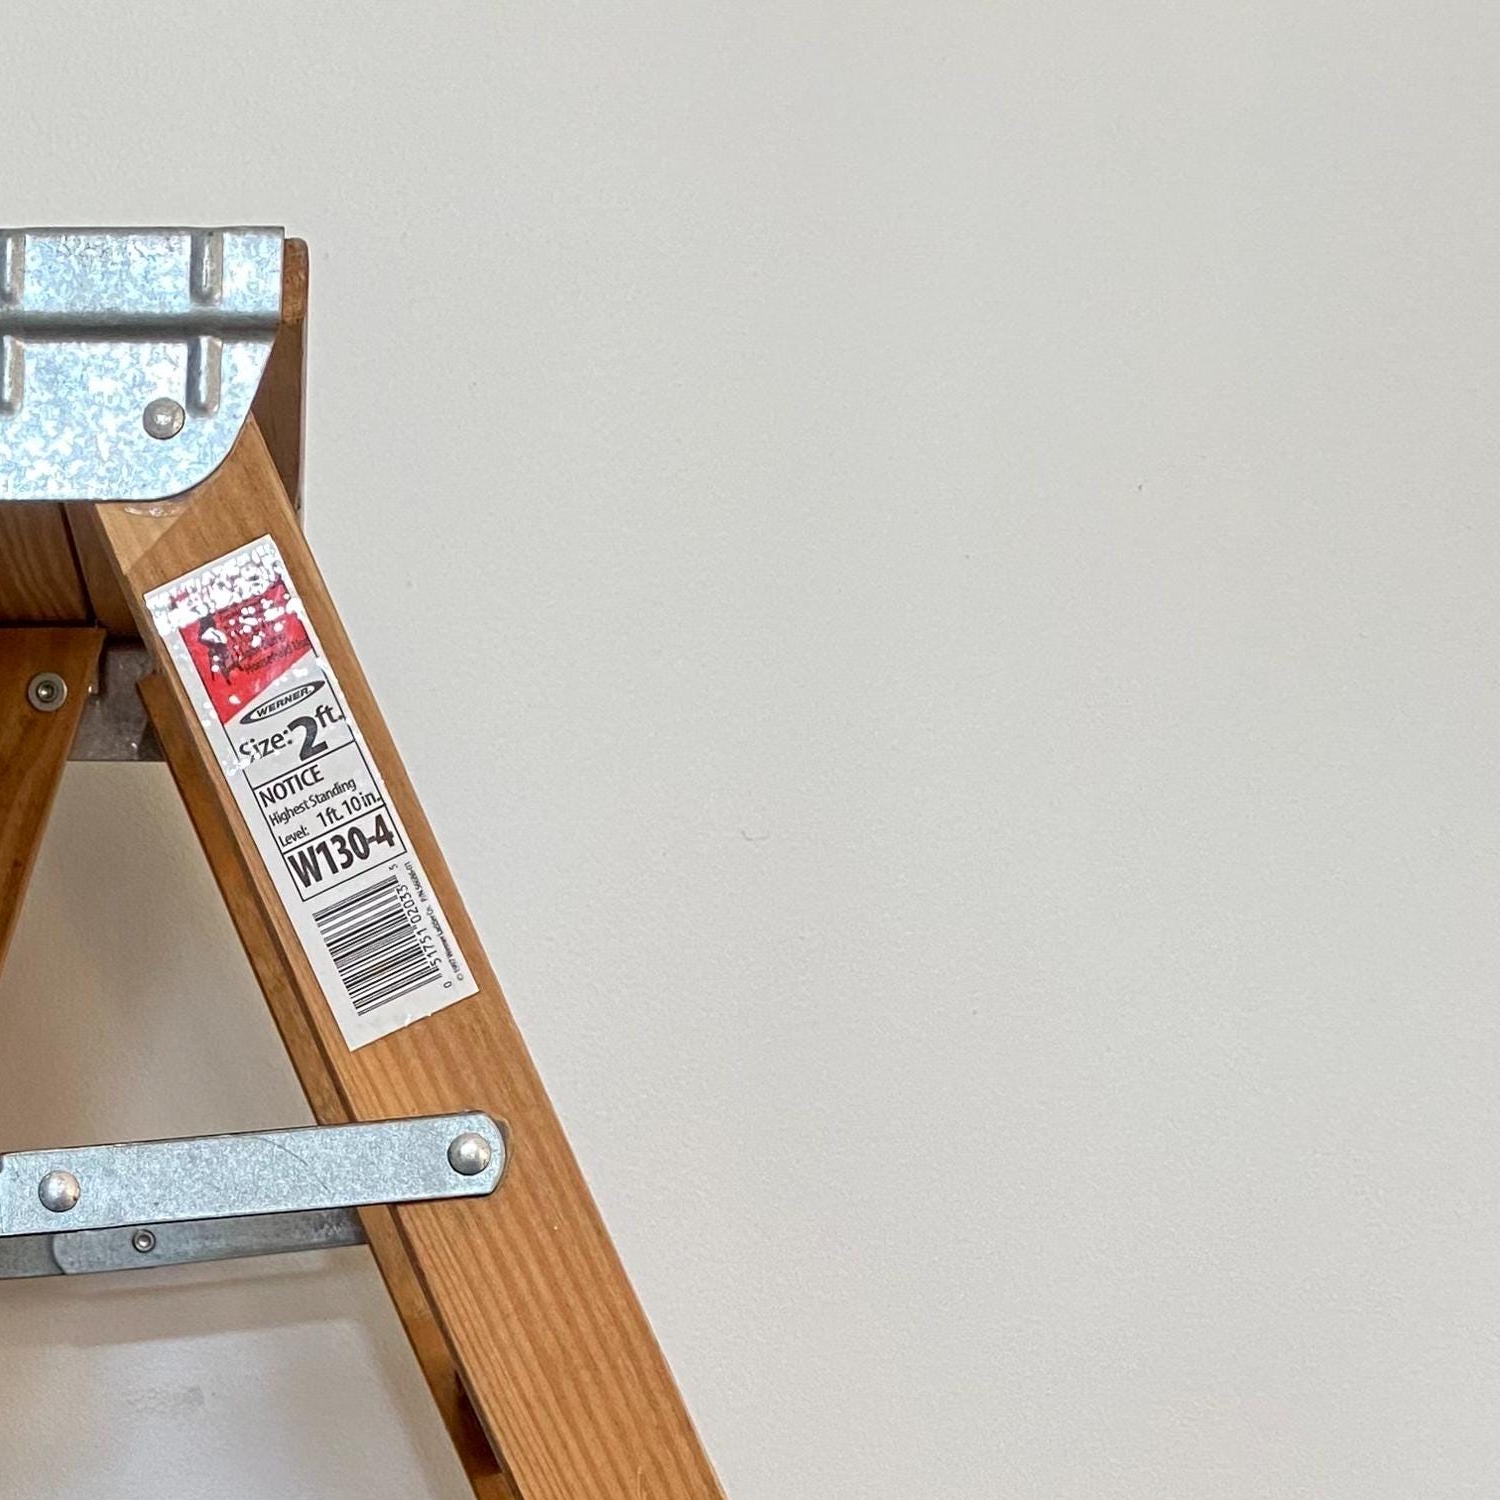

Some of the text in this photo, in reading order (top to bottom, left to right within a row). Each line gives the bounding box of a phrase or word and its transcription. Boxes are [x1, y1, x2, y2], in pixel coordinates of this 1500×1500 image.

[256, 687, 309, 717] WERNER
[258, 764, 325, 807] NOTICE
[268, 776, 357, 828] Highest Standing
[278, 823, 310, 847] Level:
[286, 813, 397, 888] W130-4
[395, 883, 422, 924] 02033
[415, 927, 442, 966] 51751
